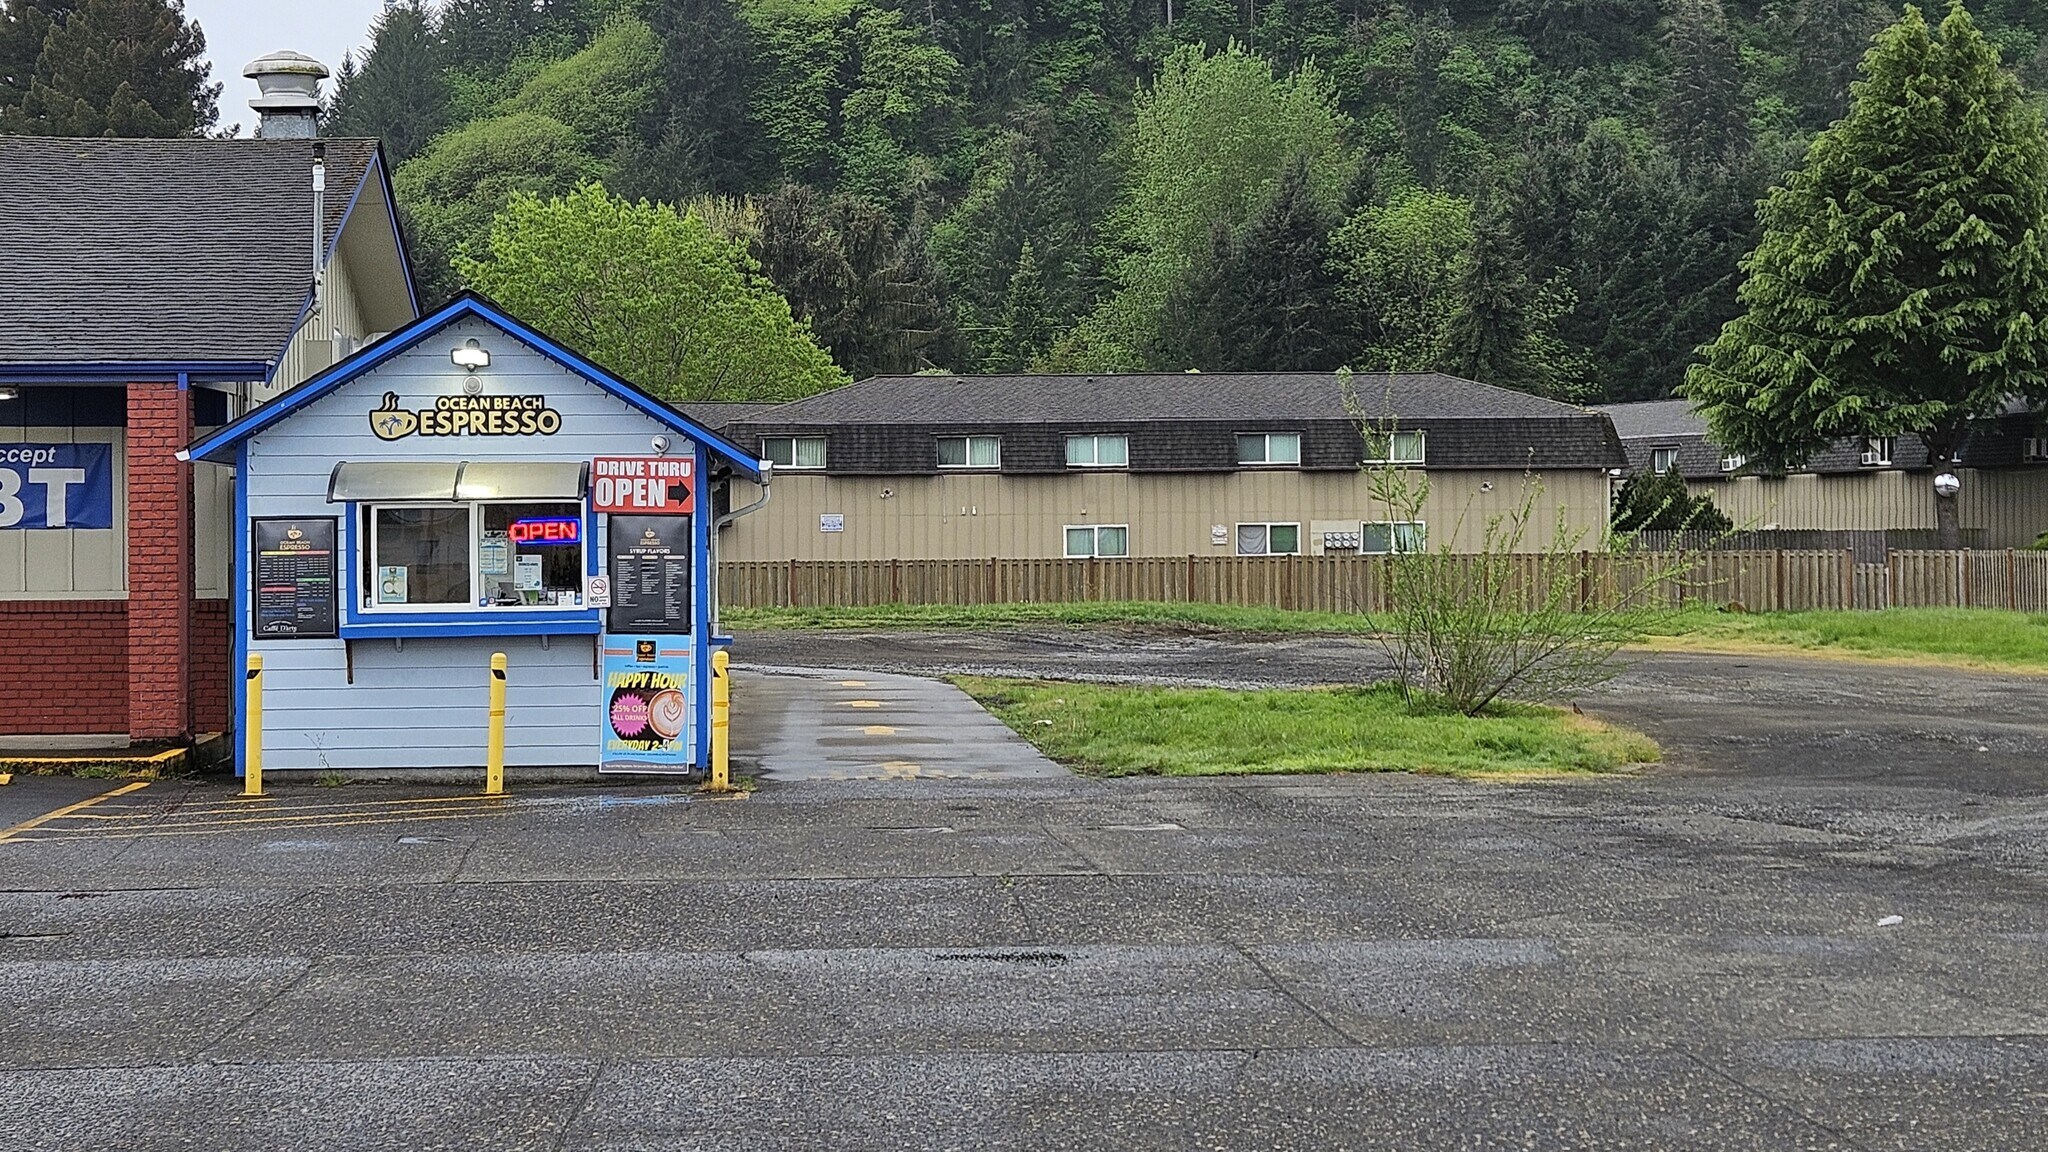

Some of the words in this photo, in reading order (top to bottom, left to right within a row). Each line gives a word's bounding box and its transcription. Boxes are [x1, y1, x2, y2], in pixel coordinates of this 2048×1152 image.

[437, 397, 490, 410] OCEAN
[494, 397, 543, 410] BEACH
[420, 410, 560, 434] ESPRESSO
[596, 461, 645, 476] DRIVE
[648, 461, 691, 477] THRU
[595, 477, 666, 507] OPEN
[509, 522, 577, 541] OPEN
[608, 673, 649, 687] HAPPY
[650, 673, 687, 688] HOUR
[614, 705, 630, 713] 25%
[608, 740, 648, 751] EVERYDAY
